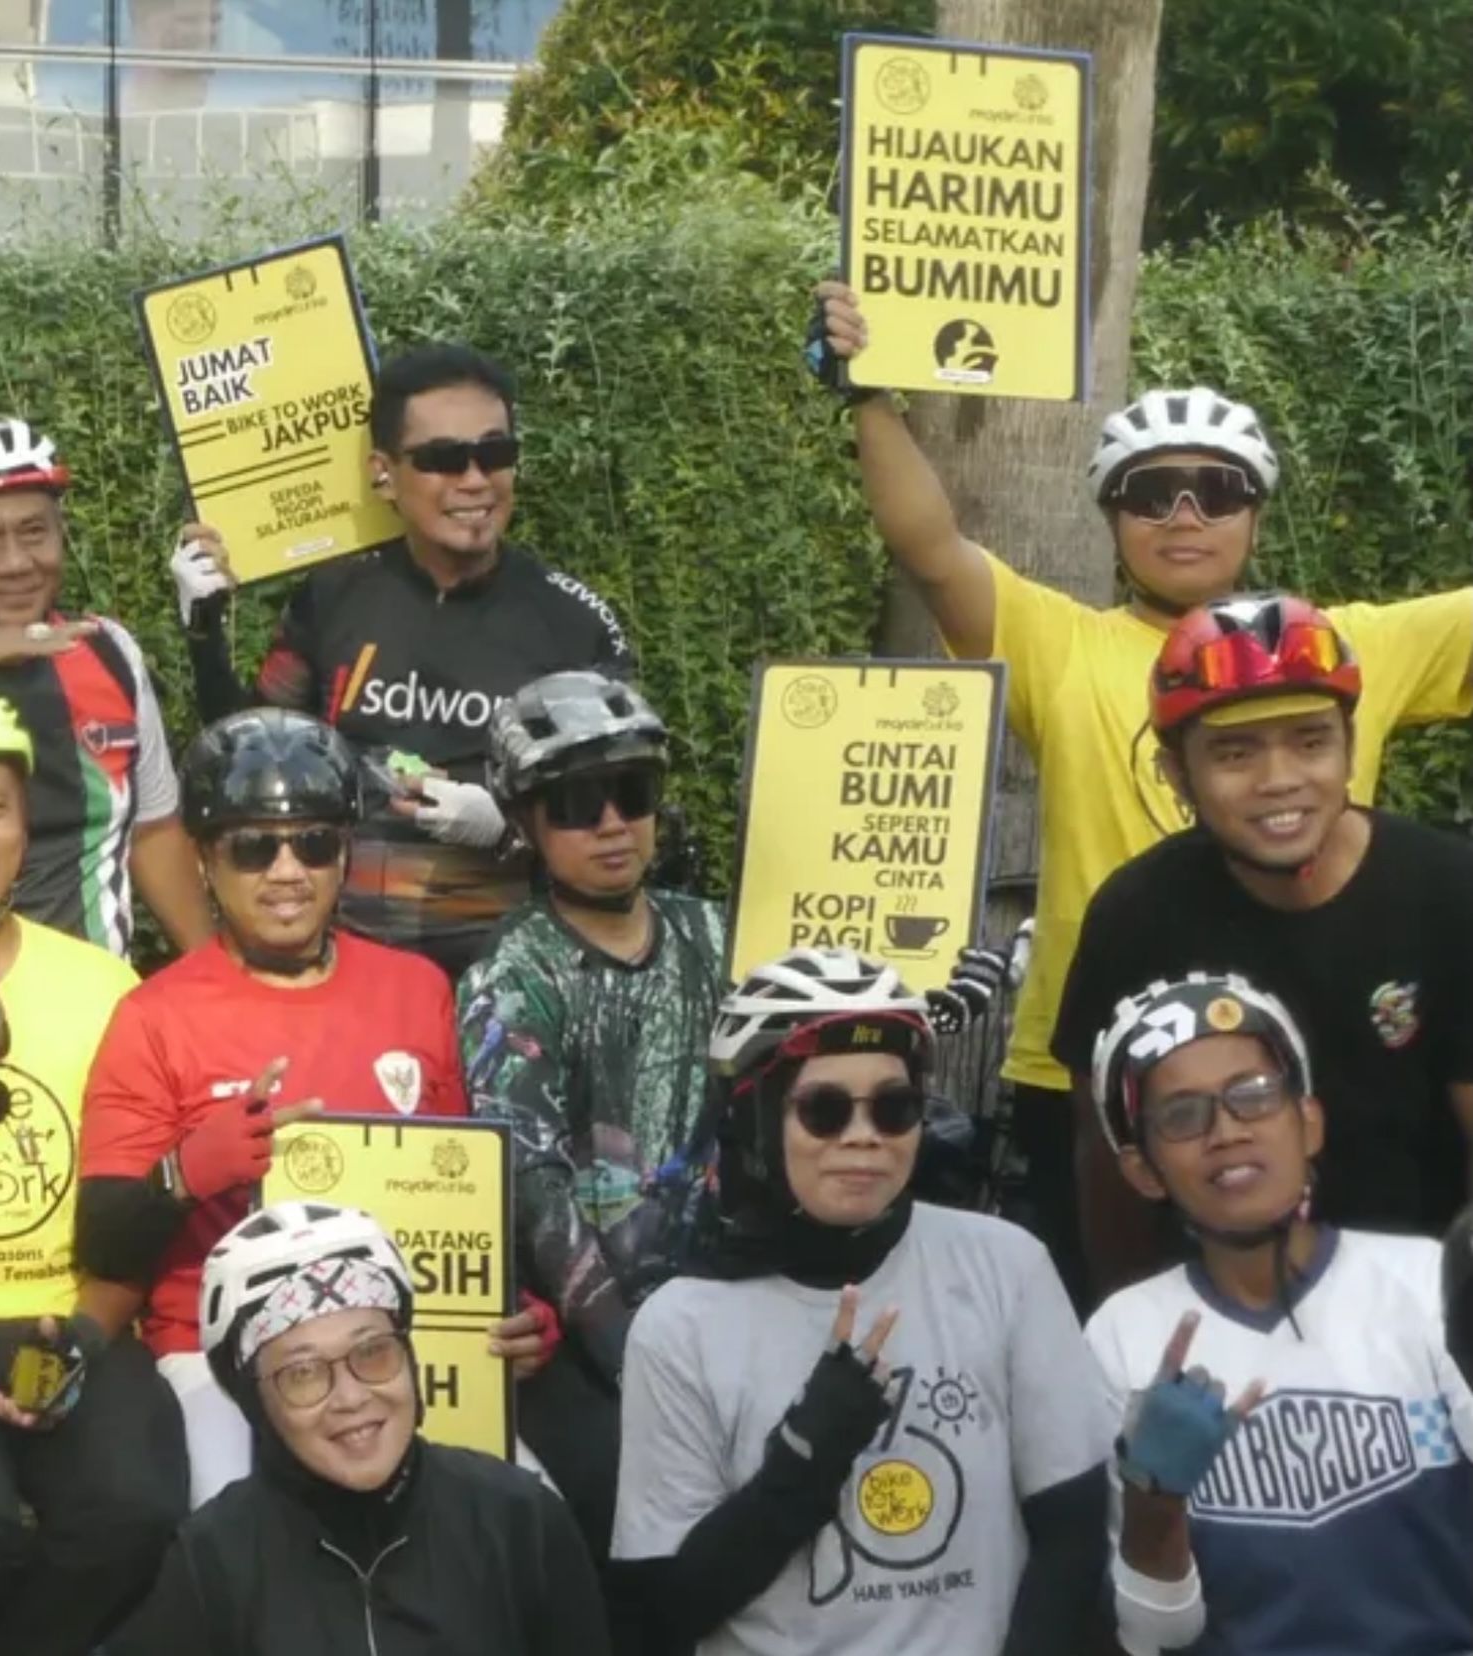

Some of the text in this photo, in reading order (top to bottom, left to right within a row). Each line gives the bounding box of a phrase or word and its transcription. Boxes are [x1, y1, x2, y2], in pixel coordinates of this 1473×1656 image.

[868, 125, 1063, 172] HIJAUKAN
[867, 167, 1063, 222] HARIMU
[863, 218, 1064, 256] SELAMATKAN
[863, 254, 1061, 307] BUMIMU
[178, 338, 270, 387] JUMAT
[184, 375, 253, 415] BAIK
[226, 383, 363, 434] BIKE TO WORK
[261, 402, 372, 452] JAKPUS
[269, 480, 324, 504] SEPEDA
[545, 570, 628, 656] sdworx
[843, 740, 956, 770] CINTAI
[840, 771, 953, 808] BUMI
[862, 813, 950, 834] SEPERTI
[832, 833, 948, 865] KAMU
[875, 869, 944, 890] CINTA
[793, 892, 875, 922] KOPI
[790, 924, 872, 952] PAGI
[395, 1229, 493, 1251] DATANG
[411, 1251, 490, 1296] SIH
